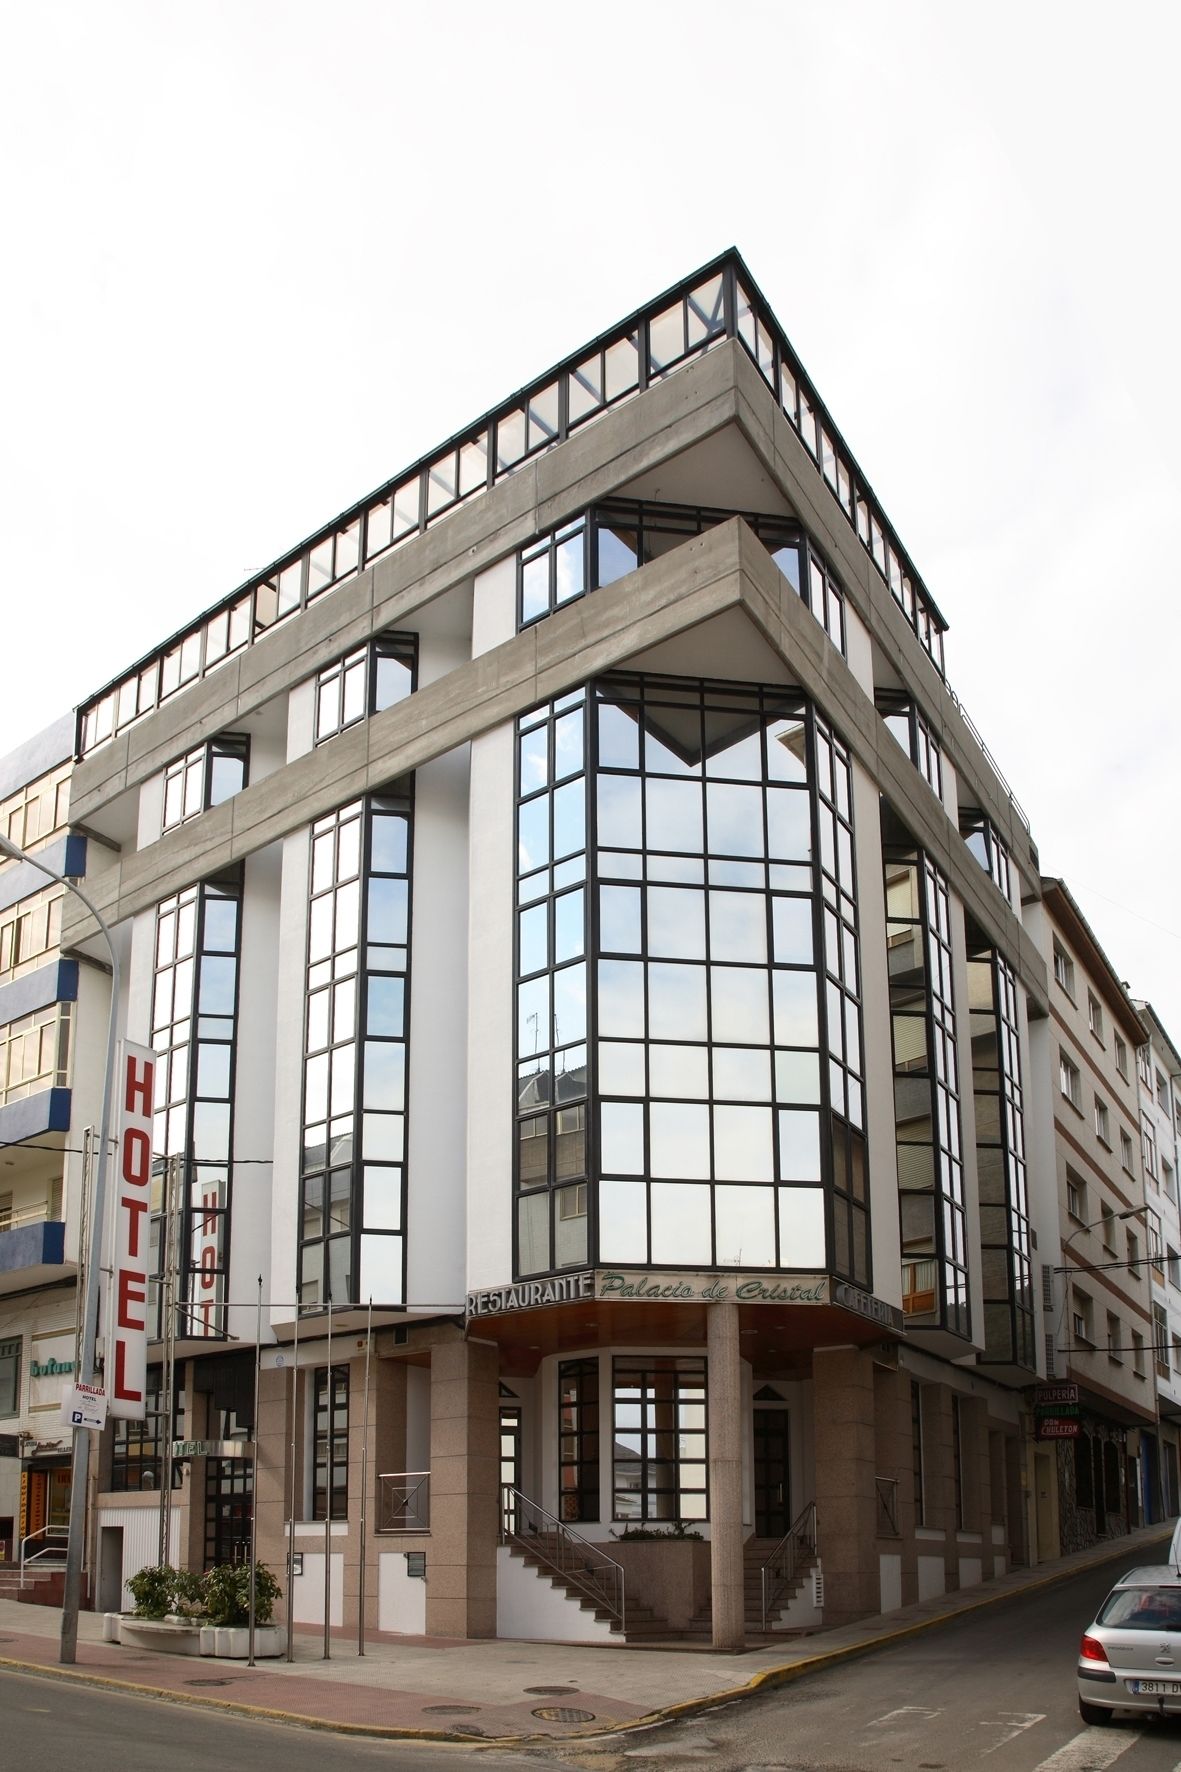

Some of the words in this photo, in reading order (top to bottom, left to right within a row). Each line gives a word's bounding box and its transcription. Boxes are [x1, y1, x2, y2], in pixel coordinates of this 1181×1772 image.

[114, 1055, 153, 1402] HOTEL
[466, 1273, 591, 1316] RESTAURANTE
[600, 1273, 694, 1299] Palacio
[702, 1280, 729, 1298] de
[736, 1280, 825, 1301] Cristal
[75, 1384, 105, 1396] PARRILLADA
[74, 1413, 81, 1421] P
[173, 1441, 207, 1456] TEL
[1142, 1682, 1166, 1693] 3811
